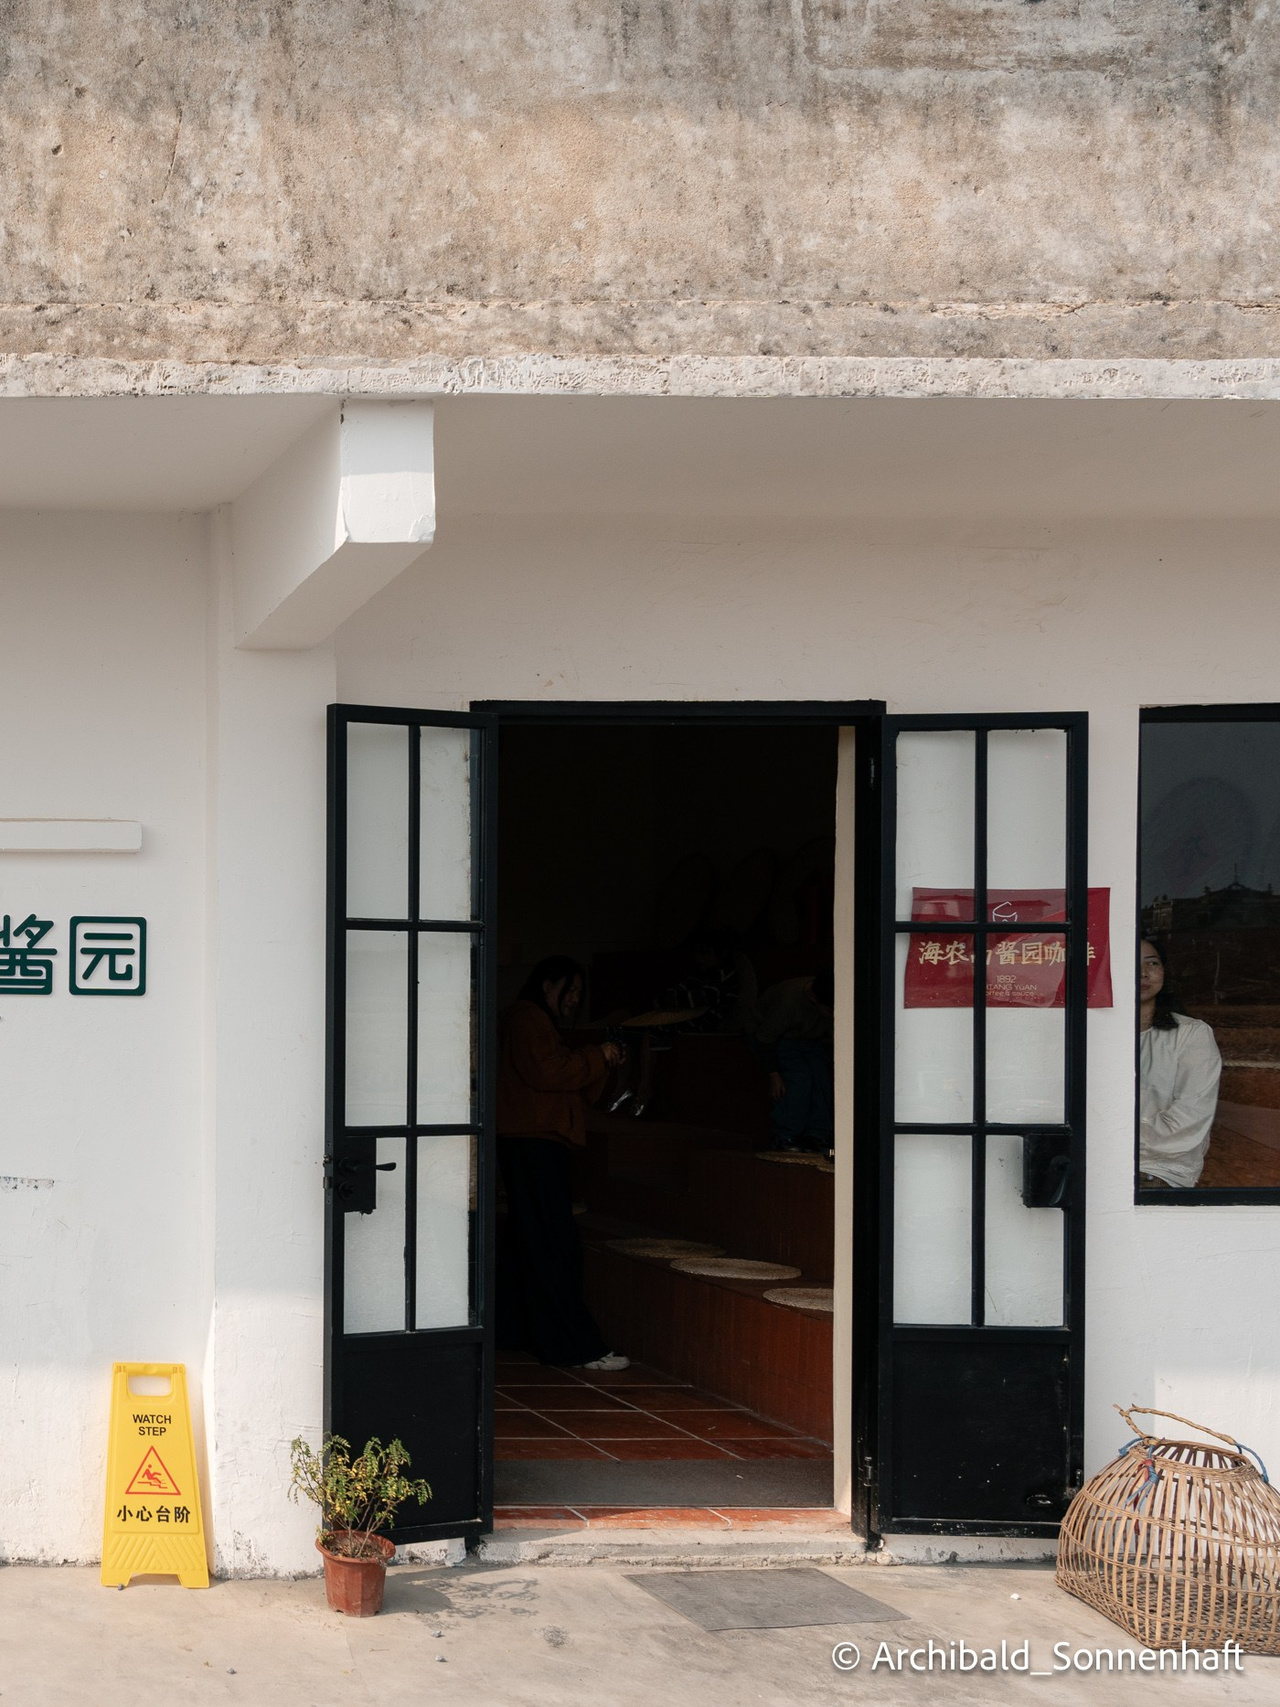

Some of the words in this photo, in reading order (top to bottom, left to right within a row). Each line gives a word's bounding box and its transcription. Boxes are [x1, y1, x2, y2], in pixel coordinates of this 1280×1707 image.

[919, 941, 1096, 966] 海农酱园咖
[996, 974, 1017, 984] 1892
[132, 1414, 172, 1424] WATCH
[138, 1426, 167, 1436] STEP
[117, 1505, 191, 1524] 小心台阶
